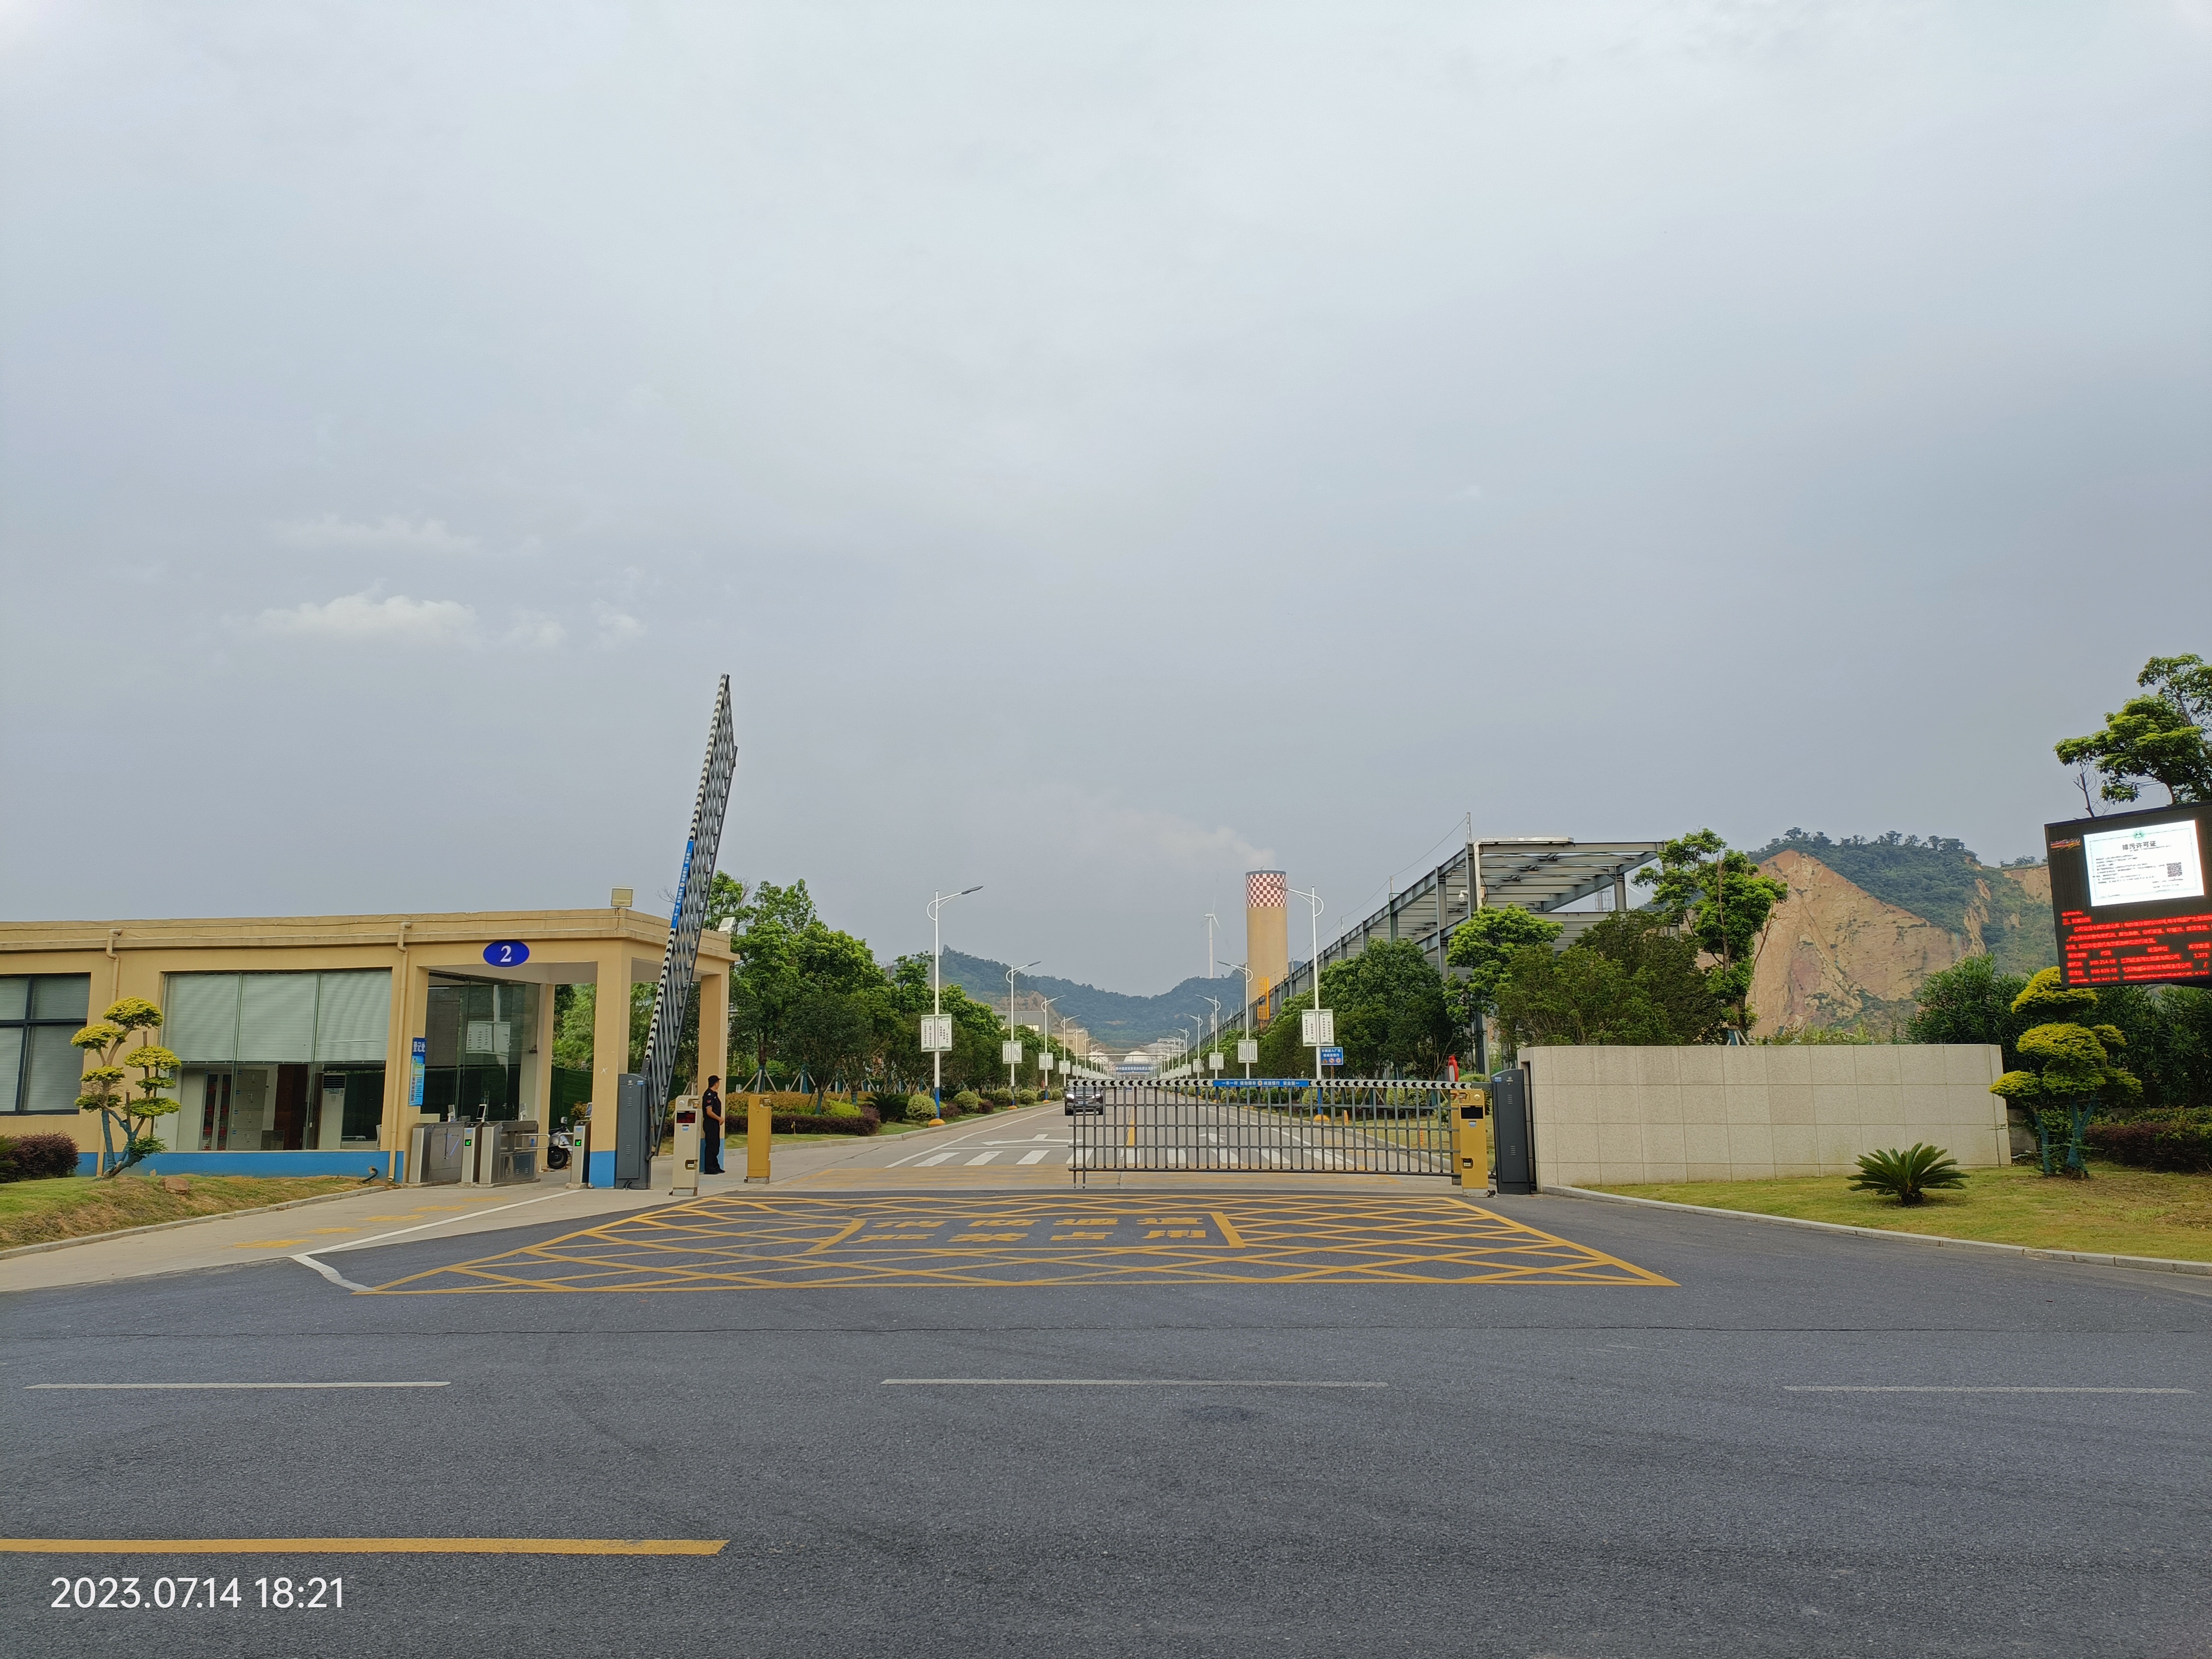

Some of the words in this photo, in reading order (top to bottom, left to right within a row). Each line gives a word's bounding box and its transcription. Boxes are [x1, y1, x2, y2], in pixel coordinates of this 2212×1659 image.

[2122, 841, 2157, 850] 排污许可证
[500, 945, 512, 962] 2
[413, 1041, 425, 1052] 登记处
[872, 1217, 1203, 1228] 消防通道
[844, 1230, 1206, 1244] 严禁占用
